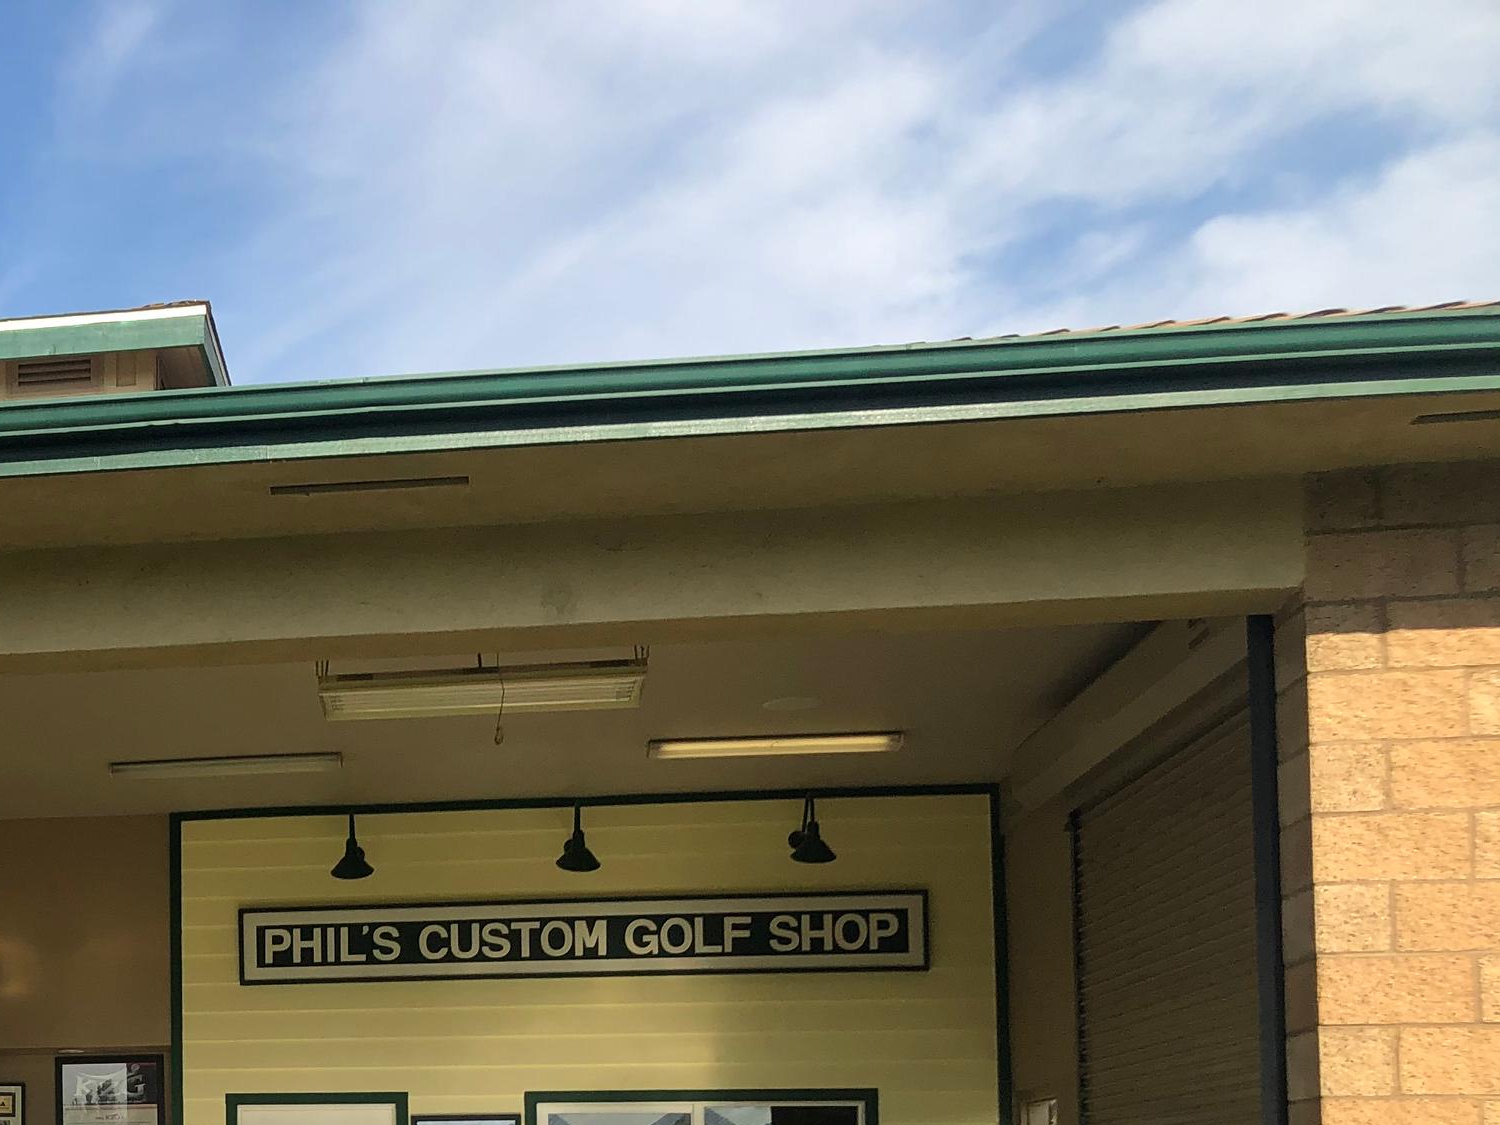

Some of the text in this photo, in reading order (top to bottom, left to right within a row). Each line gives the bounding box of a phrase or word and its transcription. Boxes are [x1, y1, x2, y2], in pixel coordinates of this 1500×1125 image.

[263, 912, 901, 964] PHIL'S CUSTOM GOLF SHOP
